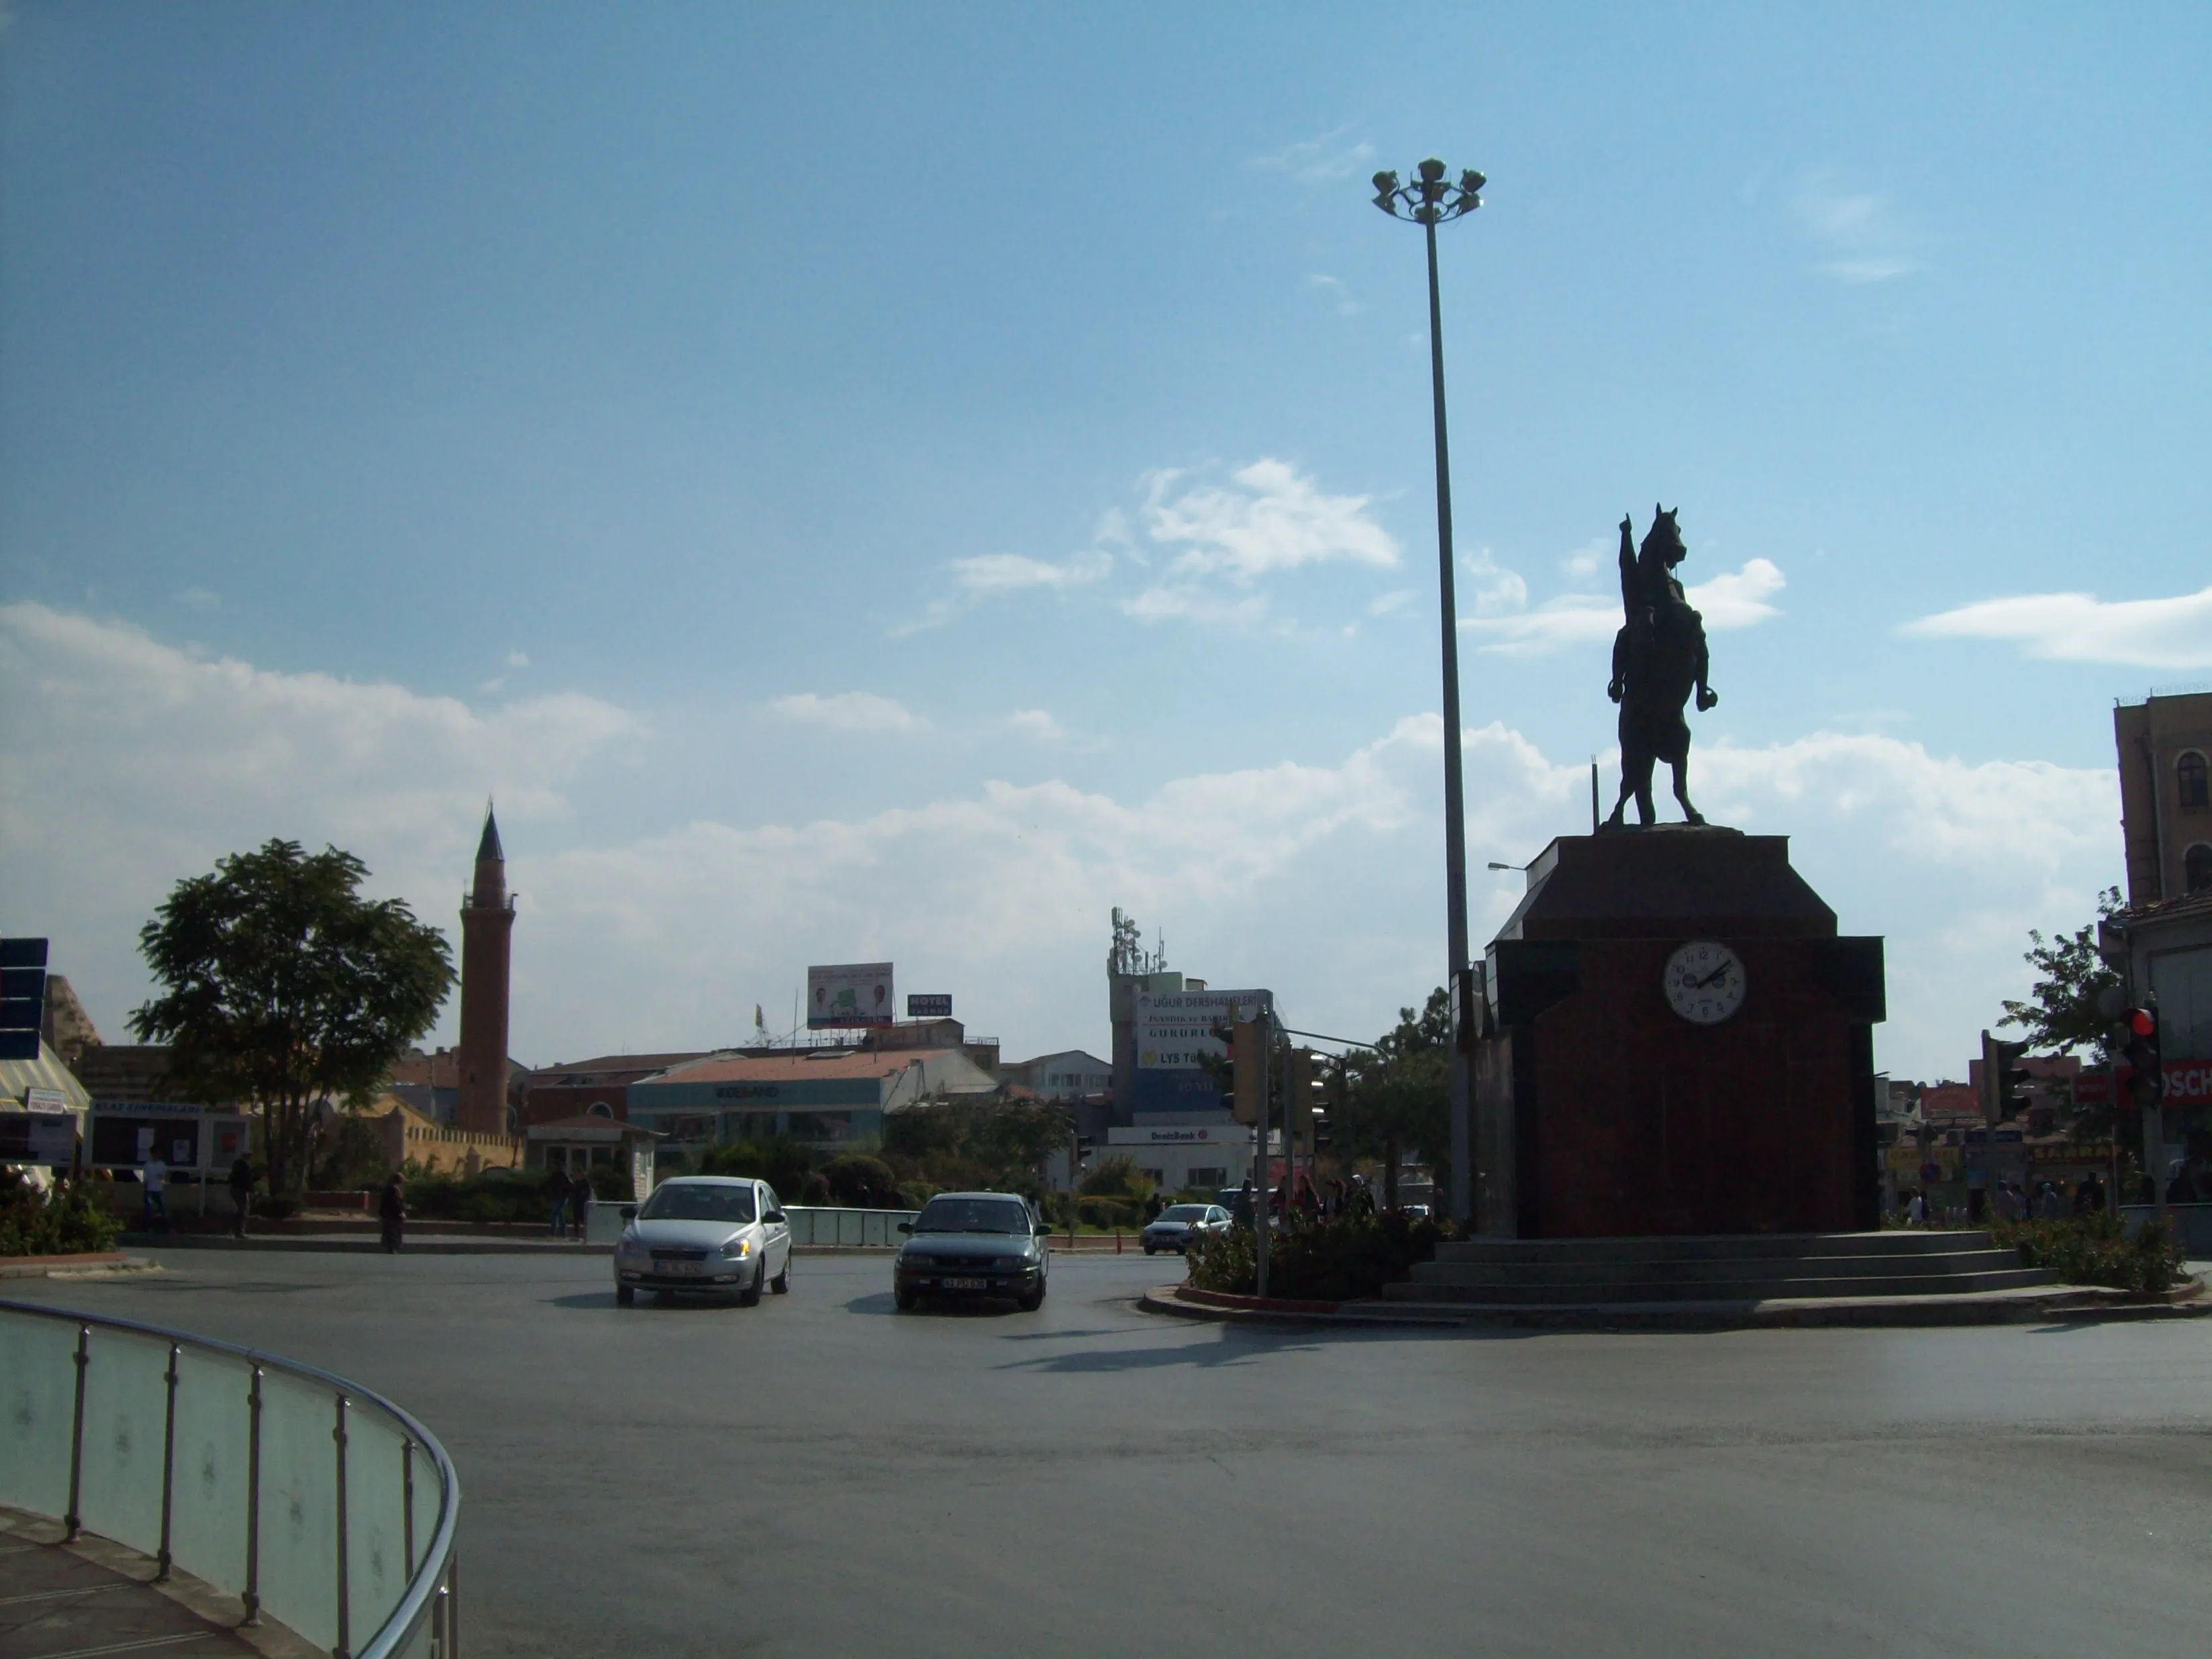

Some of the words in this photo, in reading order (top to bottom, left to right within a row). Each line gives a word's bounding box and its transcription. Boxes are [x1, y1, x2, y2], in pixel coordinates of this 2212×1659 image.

[1687, 955, 1694, 964] 11
[1699, 950, 1709, 960] 12
[1673, 978, 1680, 988] 9
[911, 996, 949, 1005] HOTEL
[1153, 994, 1183, 1008] UĞUR
[1702, 1006, 1709, 1015] 6
[1160, 1052, 1180, 1064] LYS
